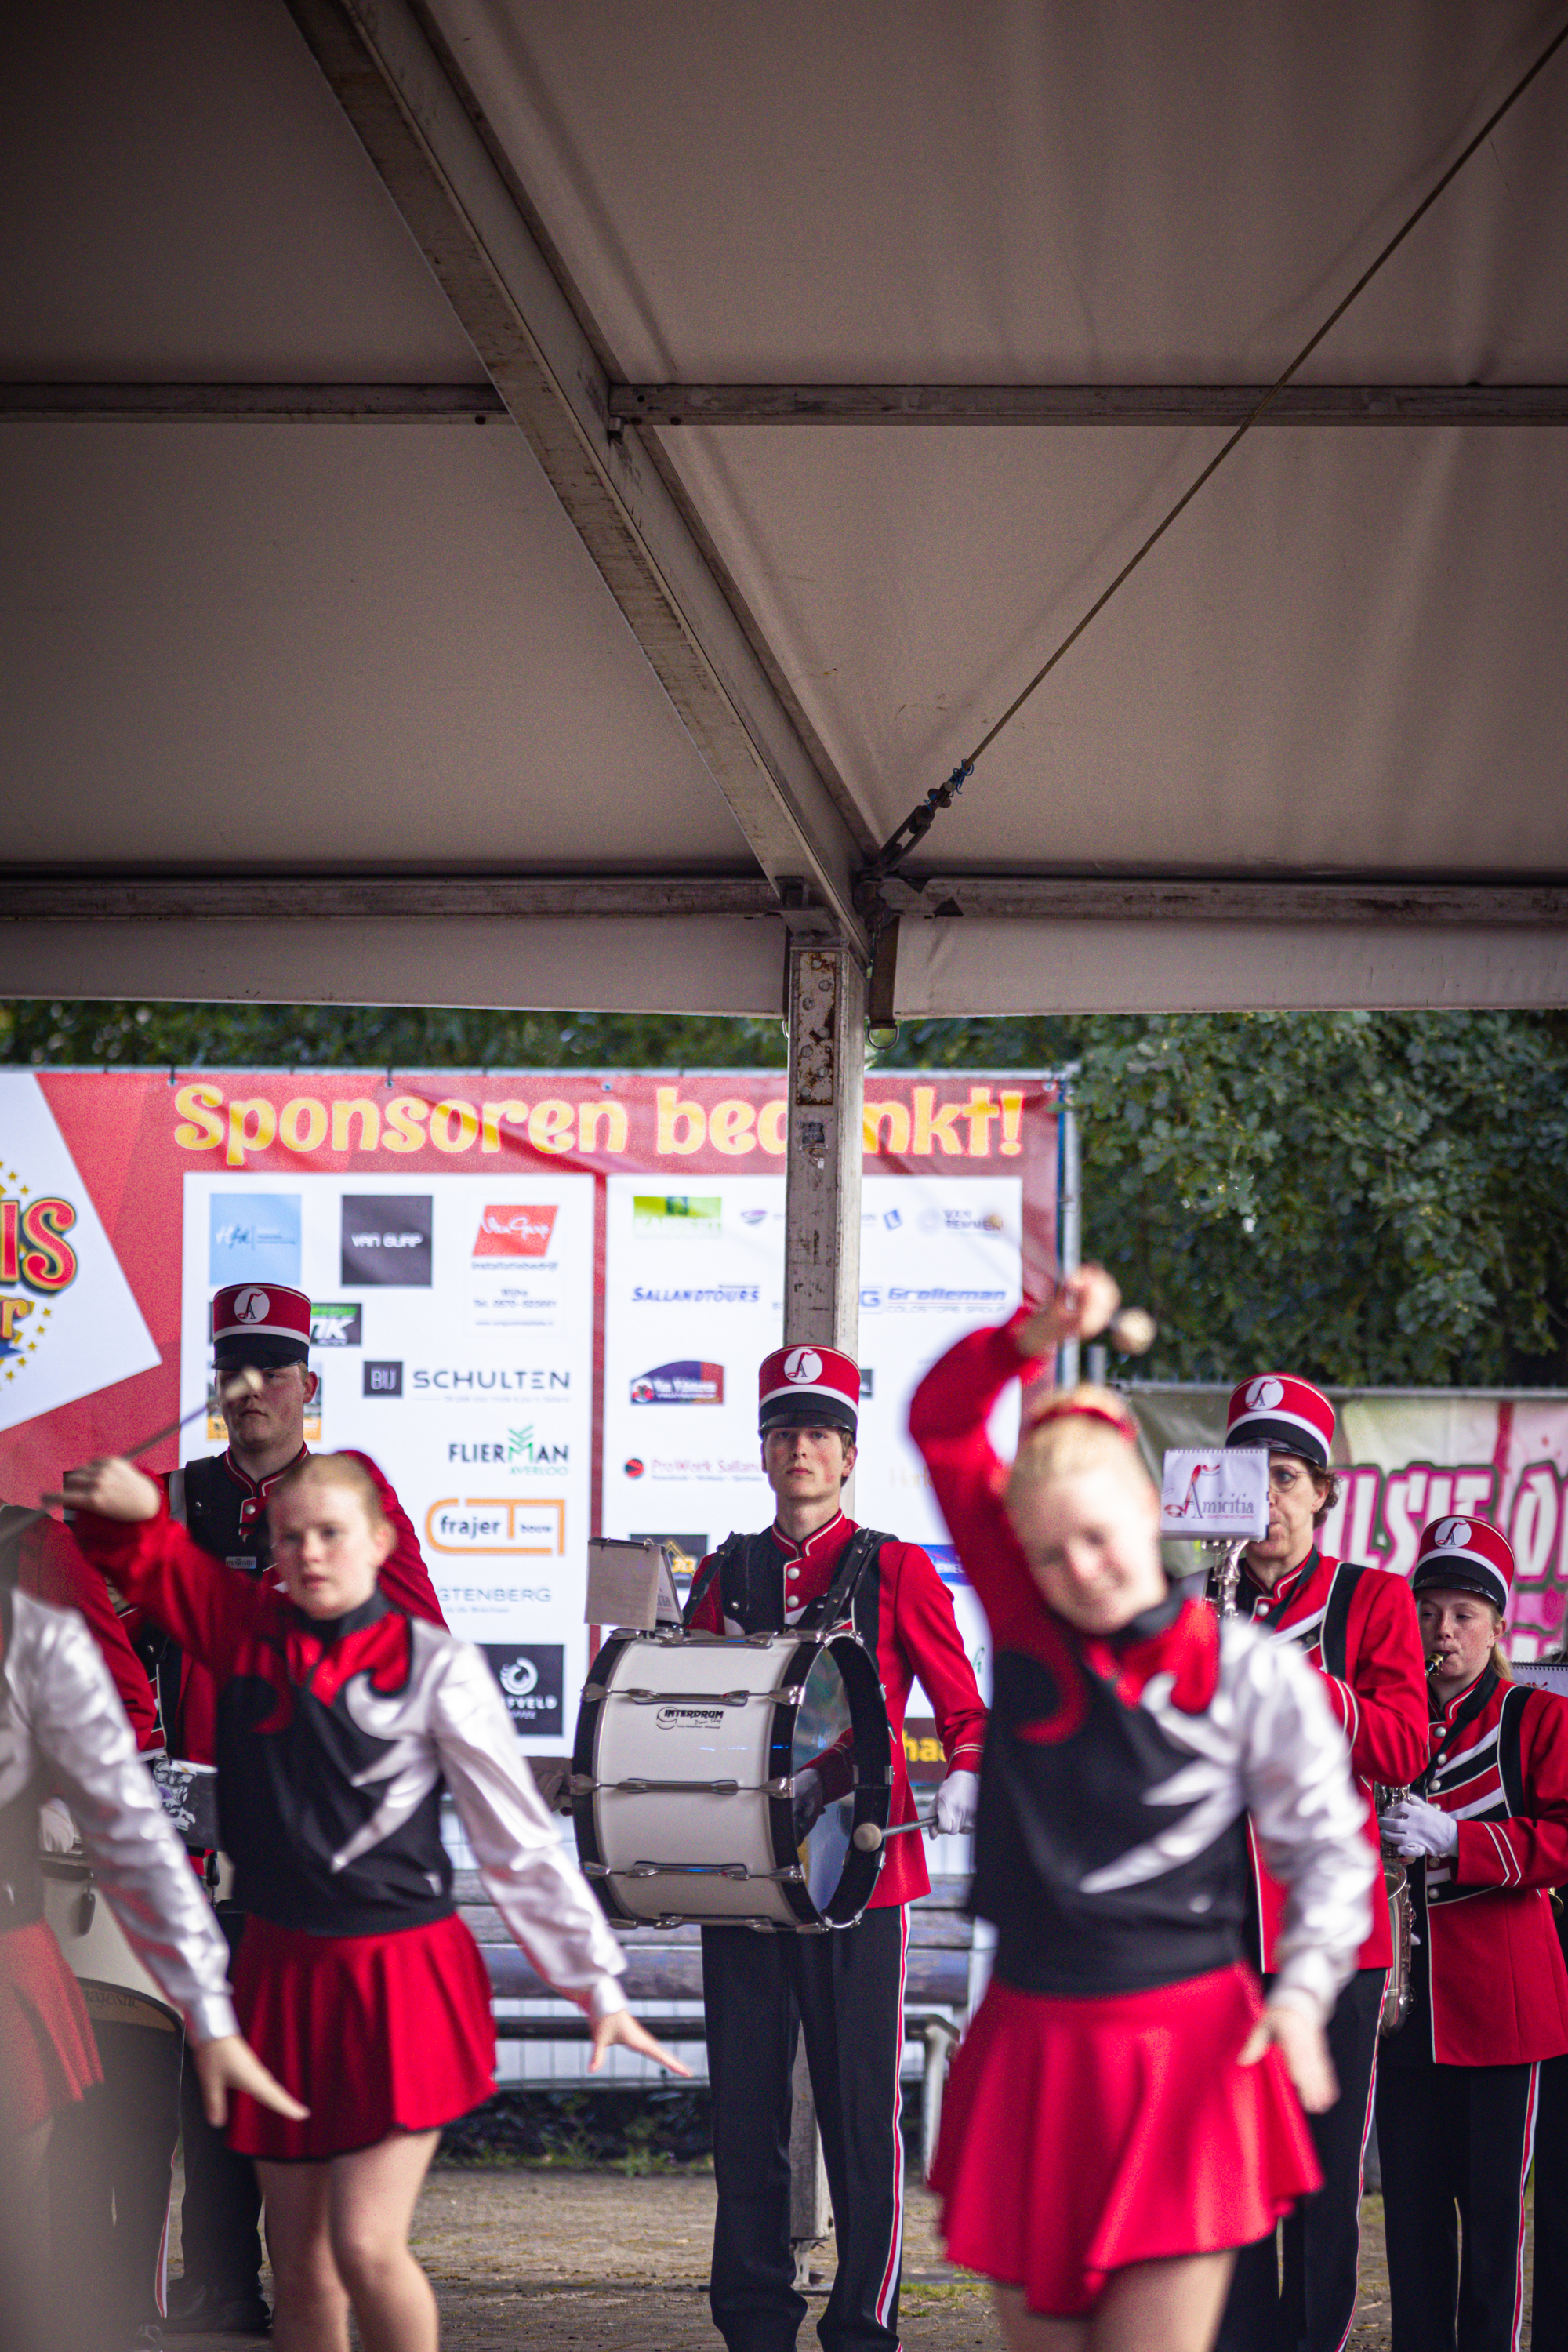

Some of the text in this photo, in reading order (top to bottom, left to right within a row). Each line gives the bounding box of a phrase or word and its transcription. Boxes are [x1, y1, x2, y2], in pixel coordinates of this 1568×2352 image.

[174, 1083, 628, 1166] Sponsoren
[413, 1371, 570, 1389] SCHULTEN
[449, 1443, 569, 1463] FLIERMAN
[1167, 1469, 1254, 1519] Amicitia
[441, 1515, 501, 1539] frajer
